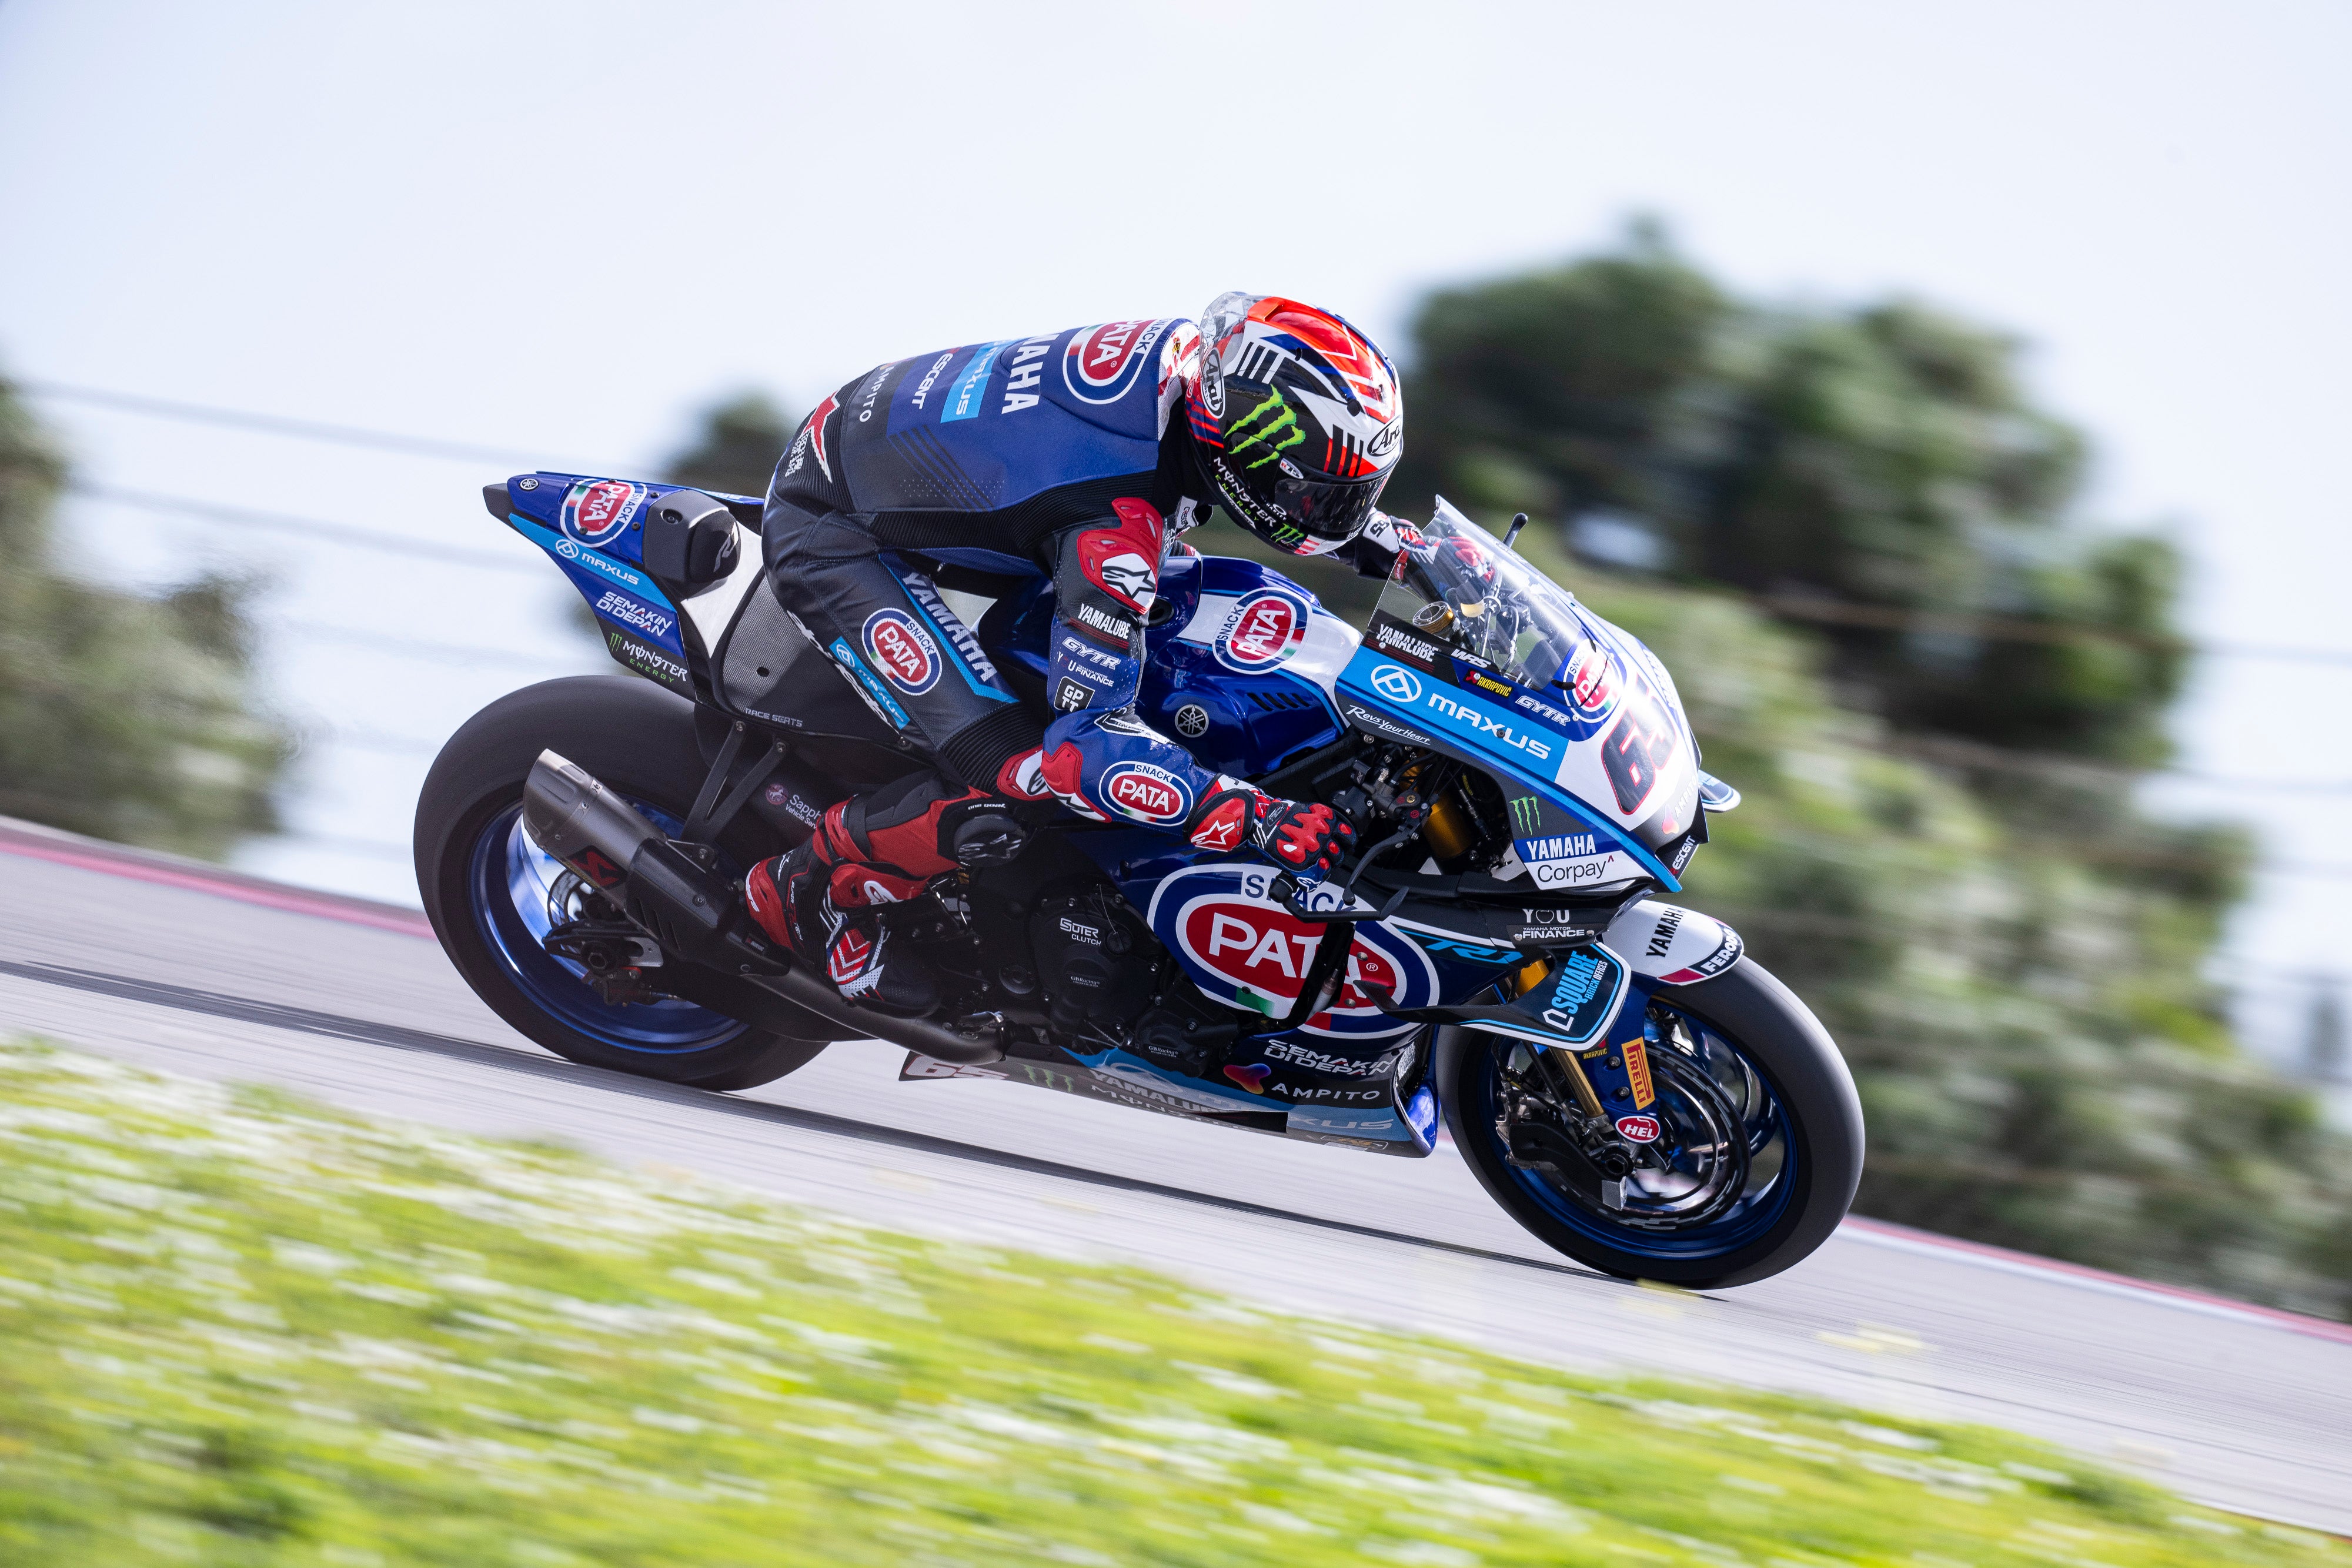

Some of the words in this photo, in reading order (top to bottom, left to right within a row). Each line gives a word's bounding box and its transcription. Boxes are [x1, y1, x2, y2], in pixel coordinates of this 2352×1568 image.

[1205, 355, 1223, 408] Arai
[618, 493, 642, 521] SNACK
[1214, 456, 1277, 527] MONSTER
[1215, 474, 1259, 521] ENERGY
[582, 553, 639, 586] MAXUS
[596, 599, 610, 613] DI
[610, 605, 667, 637] DEPAN
[604, 591, 673, 628] SEMAKIN
[1077, 603, 1131, 640] YAMALUBE
[1217, 604, 1245, 640] SNACK
[903, 572, 998, 683] YAMAHA
[906, 621, 935, 655] SNACK
[1237, 610, 1286, 656] PATA
[623, 641, 688, 682] MONSTER
[878, 626, 922, 678] PATA
[1063, 637, 1121, 670] GYTR
[1451, 649, 1492, 668] WRS
[629, 658, 674, 683] ENERGY
[1075, 667, 1114, 687] FINANCE
[1062, 696, 1079, 712] TT
[1064, 685, 1084, 700] GP
[772, 714, 803, 727] SEATS
[1428, 693, 1551, 760] MAXUS
[1515, 696, 1571, 726] GYTR
[1135, 765, 1171, 783] SNACK
[790, 794, 821, 820] Sapph
[1118, 778, 1169, 812] PATA
[786, 804, 805, 821] Vehicle
[1526, 834, 1596, 860] YAMAHA
[1538, 861, 1606, 882] Corpay
[1060, 917, 1099, 938] SUTER
[1071, 934, 1101, 947] CLUTCH
[1523, 930, 1585, 939] FINANCE
[1646, 908, 1686, 958] YAMAHA
[1700, 927, 1739, 972] FERODO
[1551, 950, 1599, 1014] SQUARE
[1584, 978, 1599, 1000] BRICK
[1593, 960, 1608, 980] OFFICES
[1268, 1039, 1394, 1069] SEMAKIN
[1295, 1057, 1391, 1076] DEPAN
[1626, 1043, 1651, 1103] PIRELLI
[1089, 1069, 1231, 1113] YAMALUB
[1271, 1083, 1380, 1101] AMPITO
[1624, 1124, 1654, 1138] HEL
